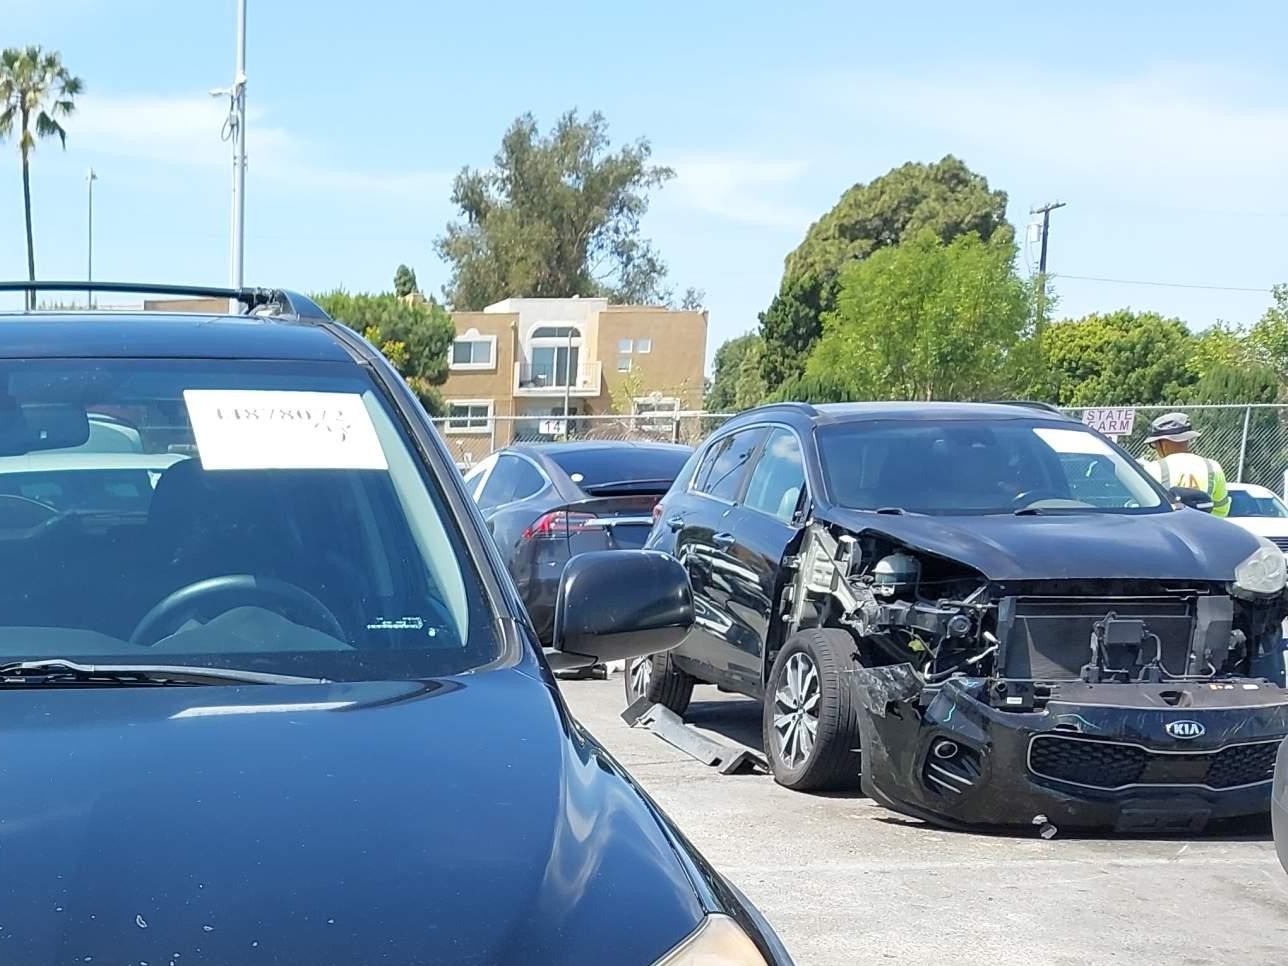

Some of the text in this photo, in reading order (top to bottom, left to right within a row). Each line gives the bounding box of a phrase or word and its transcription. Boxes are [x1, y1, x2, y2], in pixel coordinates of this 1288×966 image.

[1087, 409, 1133, 421] STATE
[544, 420, 561, 433] 14
[1173, 723, 1200, 735] KIA
